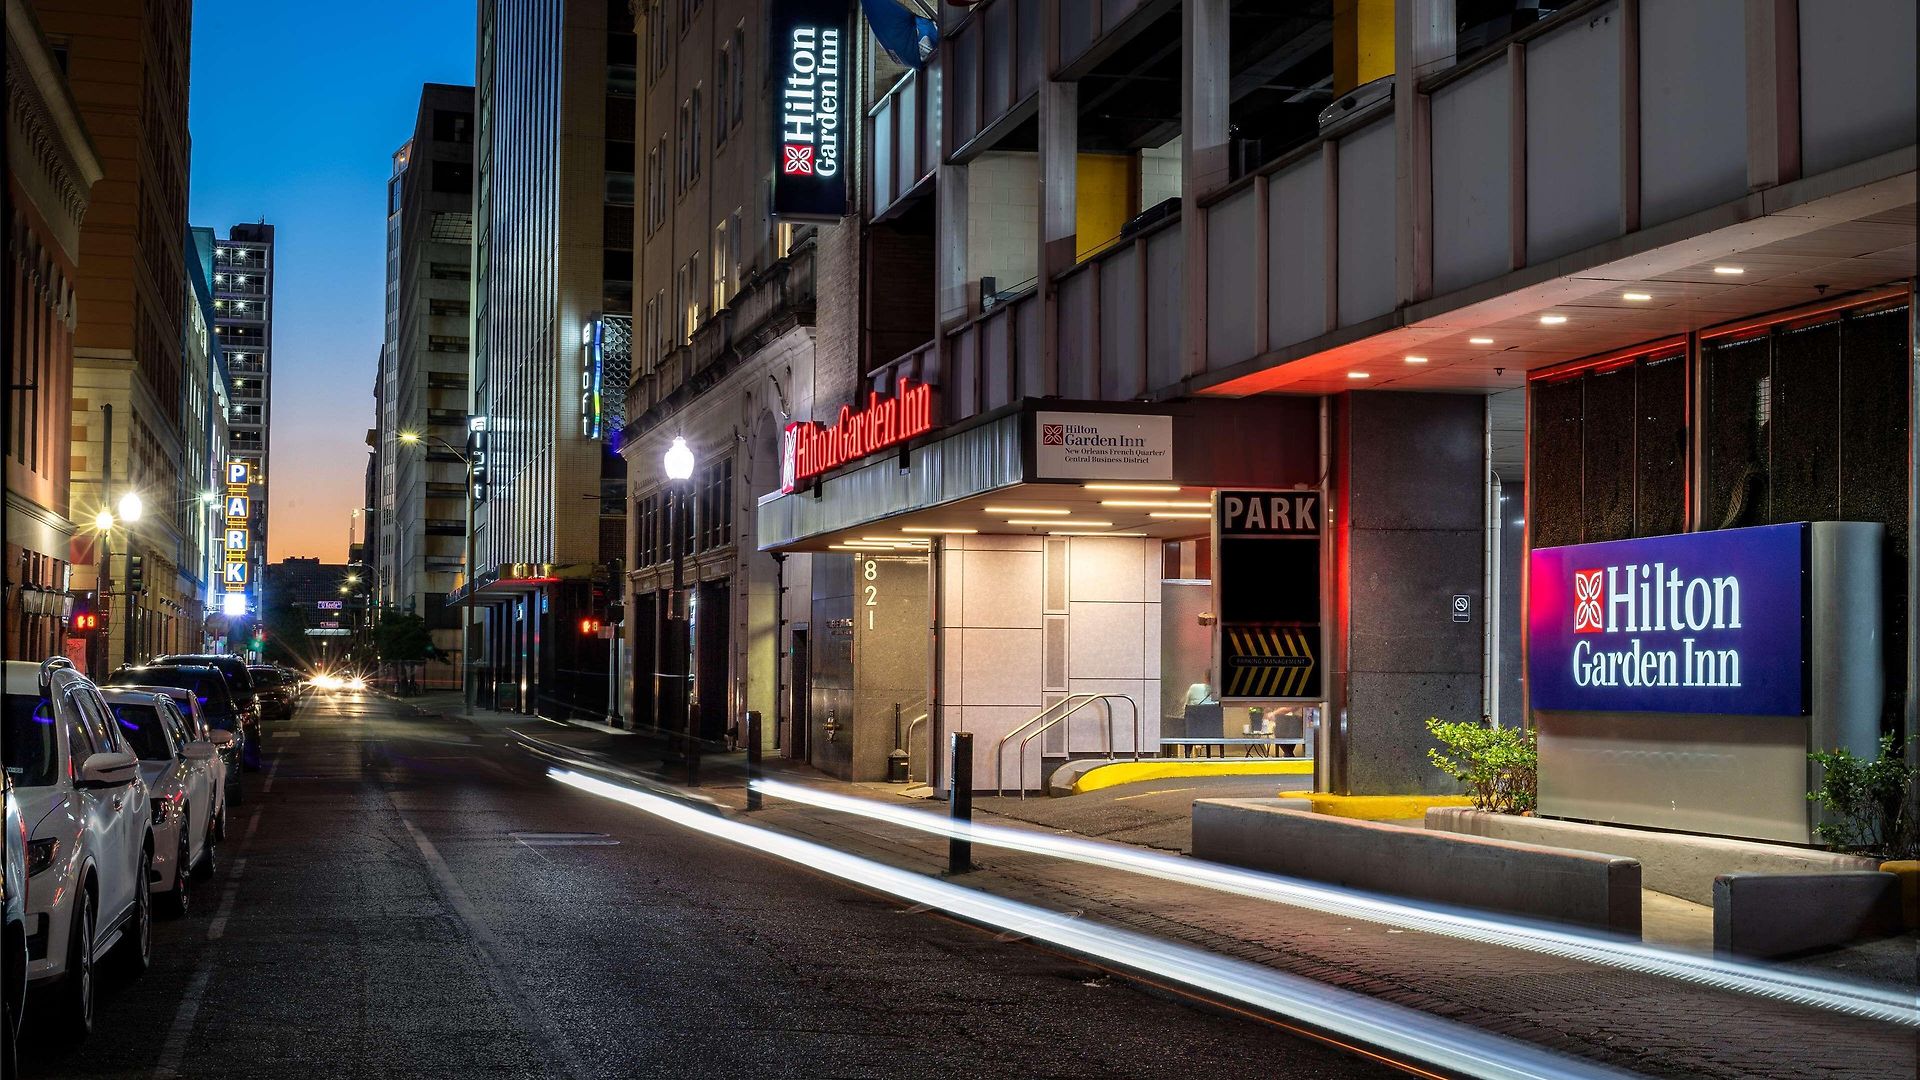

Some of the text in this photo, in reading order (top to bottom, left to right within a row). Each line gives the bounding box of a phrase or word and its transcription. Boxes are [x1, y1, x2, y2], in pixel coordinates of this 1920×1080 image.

[785, 27, 815, 143] Hilton
[816, 29, 838, 177] Garden Inn
[582, 322, 591, 436] aloft
[796, 377, 931, 478] Hilton Garden Inn
[1065, 424, 1098, 434] Hilton
[1065, 433, 1145, 447] Garden Inn
[1065, 455, 1091, 463] Central
[1123, 456, 1149, 464] District
[1109, 448, 1135, 456] French
[1135, 449, 1166, 457] Quarter/
[227, 464, 246, 582] PARK
[1224, 497, 1315, 529] PARK
[864, 560, 878, 630] 821
[1606, 562, 1742, 633] Hilton
[1573, 638, 1742, 687] Garden Inn
